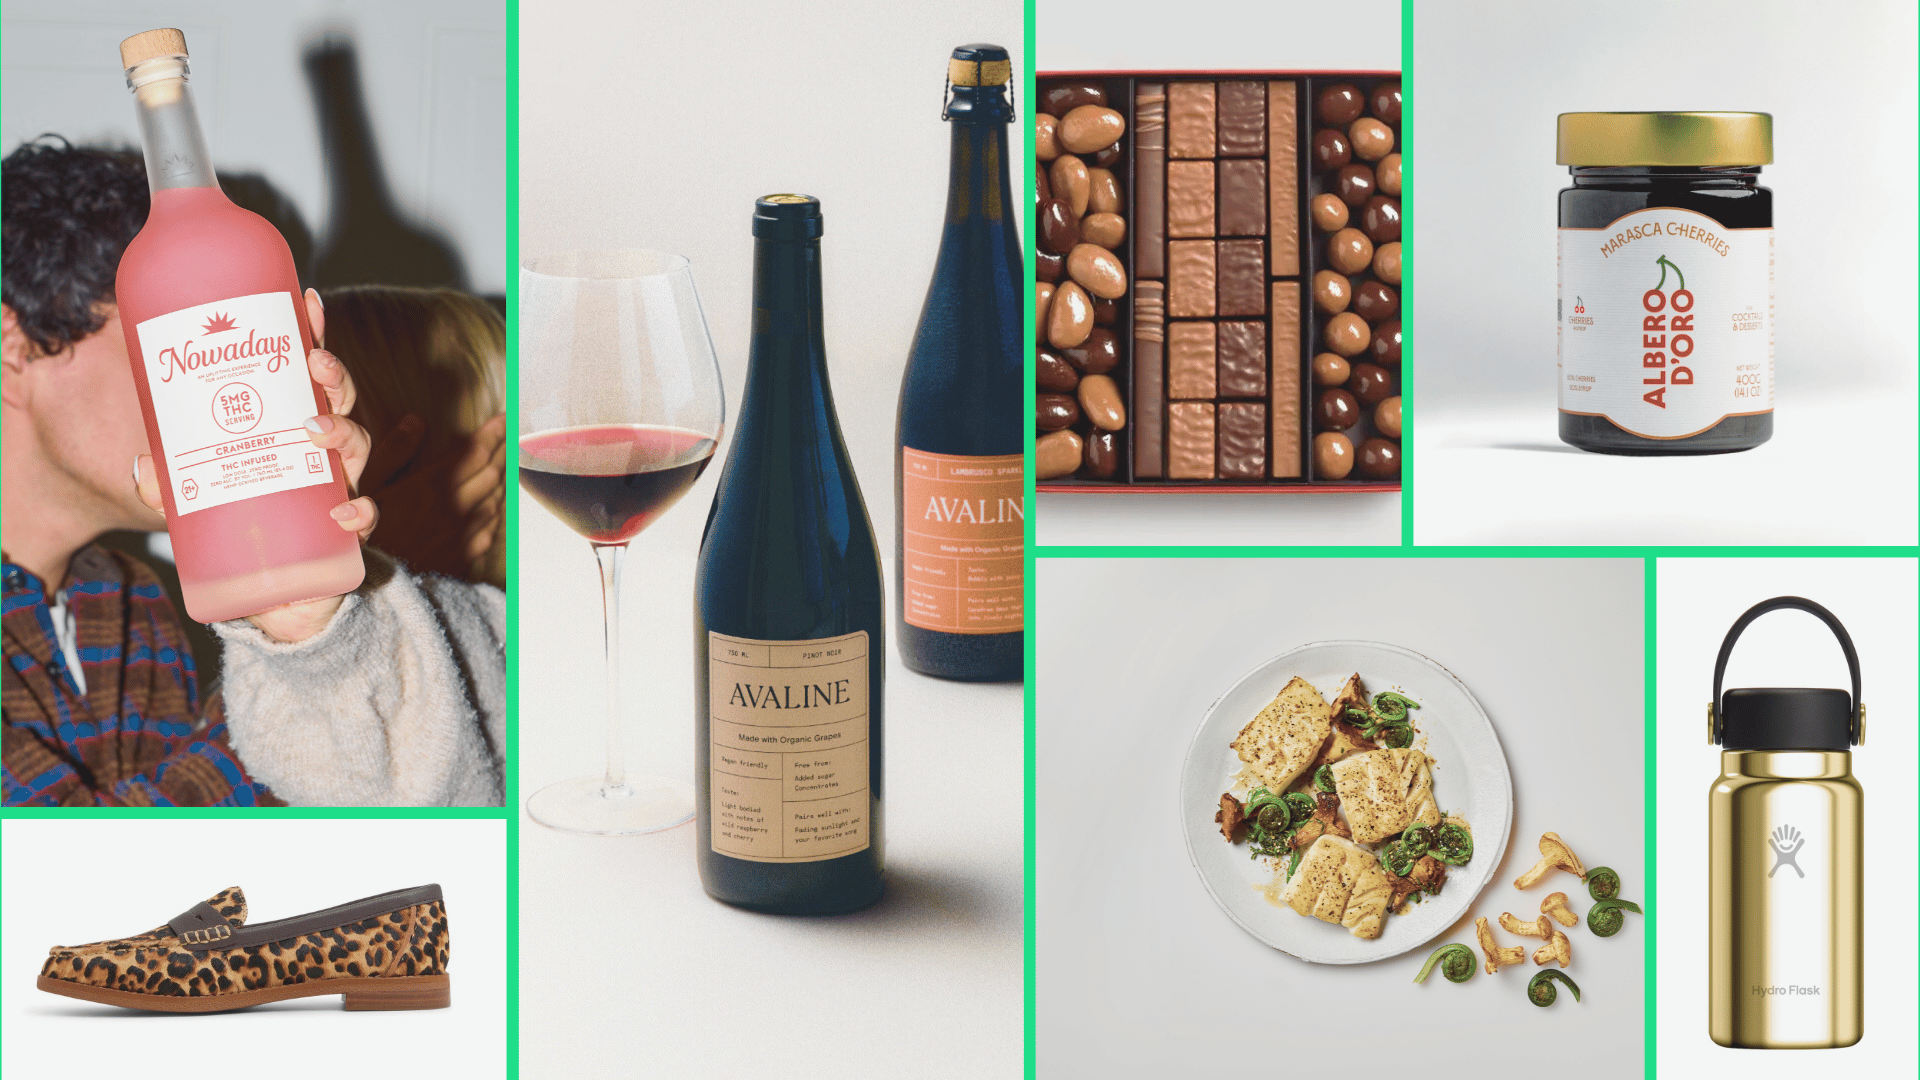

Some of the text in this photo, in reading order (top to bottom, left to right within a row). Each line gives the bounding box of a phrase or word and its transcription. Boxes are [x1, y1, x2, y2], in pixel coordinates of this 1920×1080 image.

[1600, 222, 1730, 259] MARASCA CHERRIES
[1670, 289, 1694, 385] D'ORO
[159, 328, 291, 383] Nowadays
[1642, 289, 1666, 409] ALBERO
[220, 390, 250, 406] 5MG
[223, 402, 252, 417] THC
[224, 413, 255, 426] SERVING
[215, 435, 276, 456] CRANBERRY
[221, 453, 277, 471] THC INFUSED
[950, 467, 993, 476] LAMBRUSCO
[802, 648, 842, 660] PINOT NOIR
[729, 678, 850, 709] AVALINE
[738, 731, 842, 745] Made with Organic Grapes
[740, 759, 768, 770] friendly
[794, 772, 836, 782] Added sugar
[794, 782, 839, 791] Concentrates
[739, 805, 762, 813] bodied
[817, 810, 832, 818] well
[820, 821, 848, 831] sunlight
[814, 832, 843, 841] favorite
[1751, 984, 1821, 998] Hydro Flask
